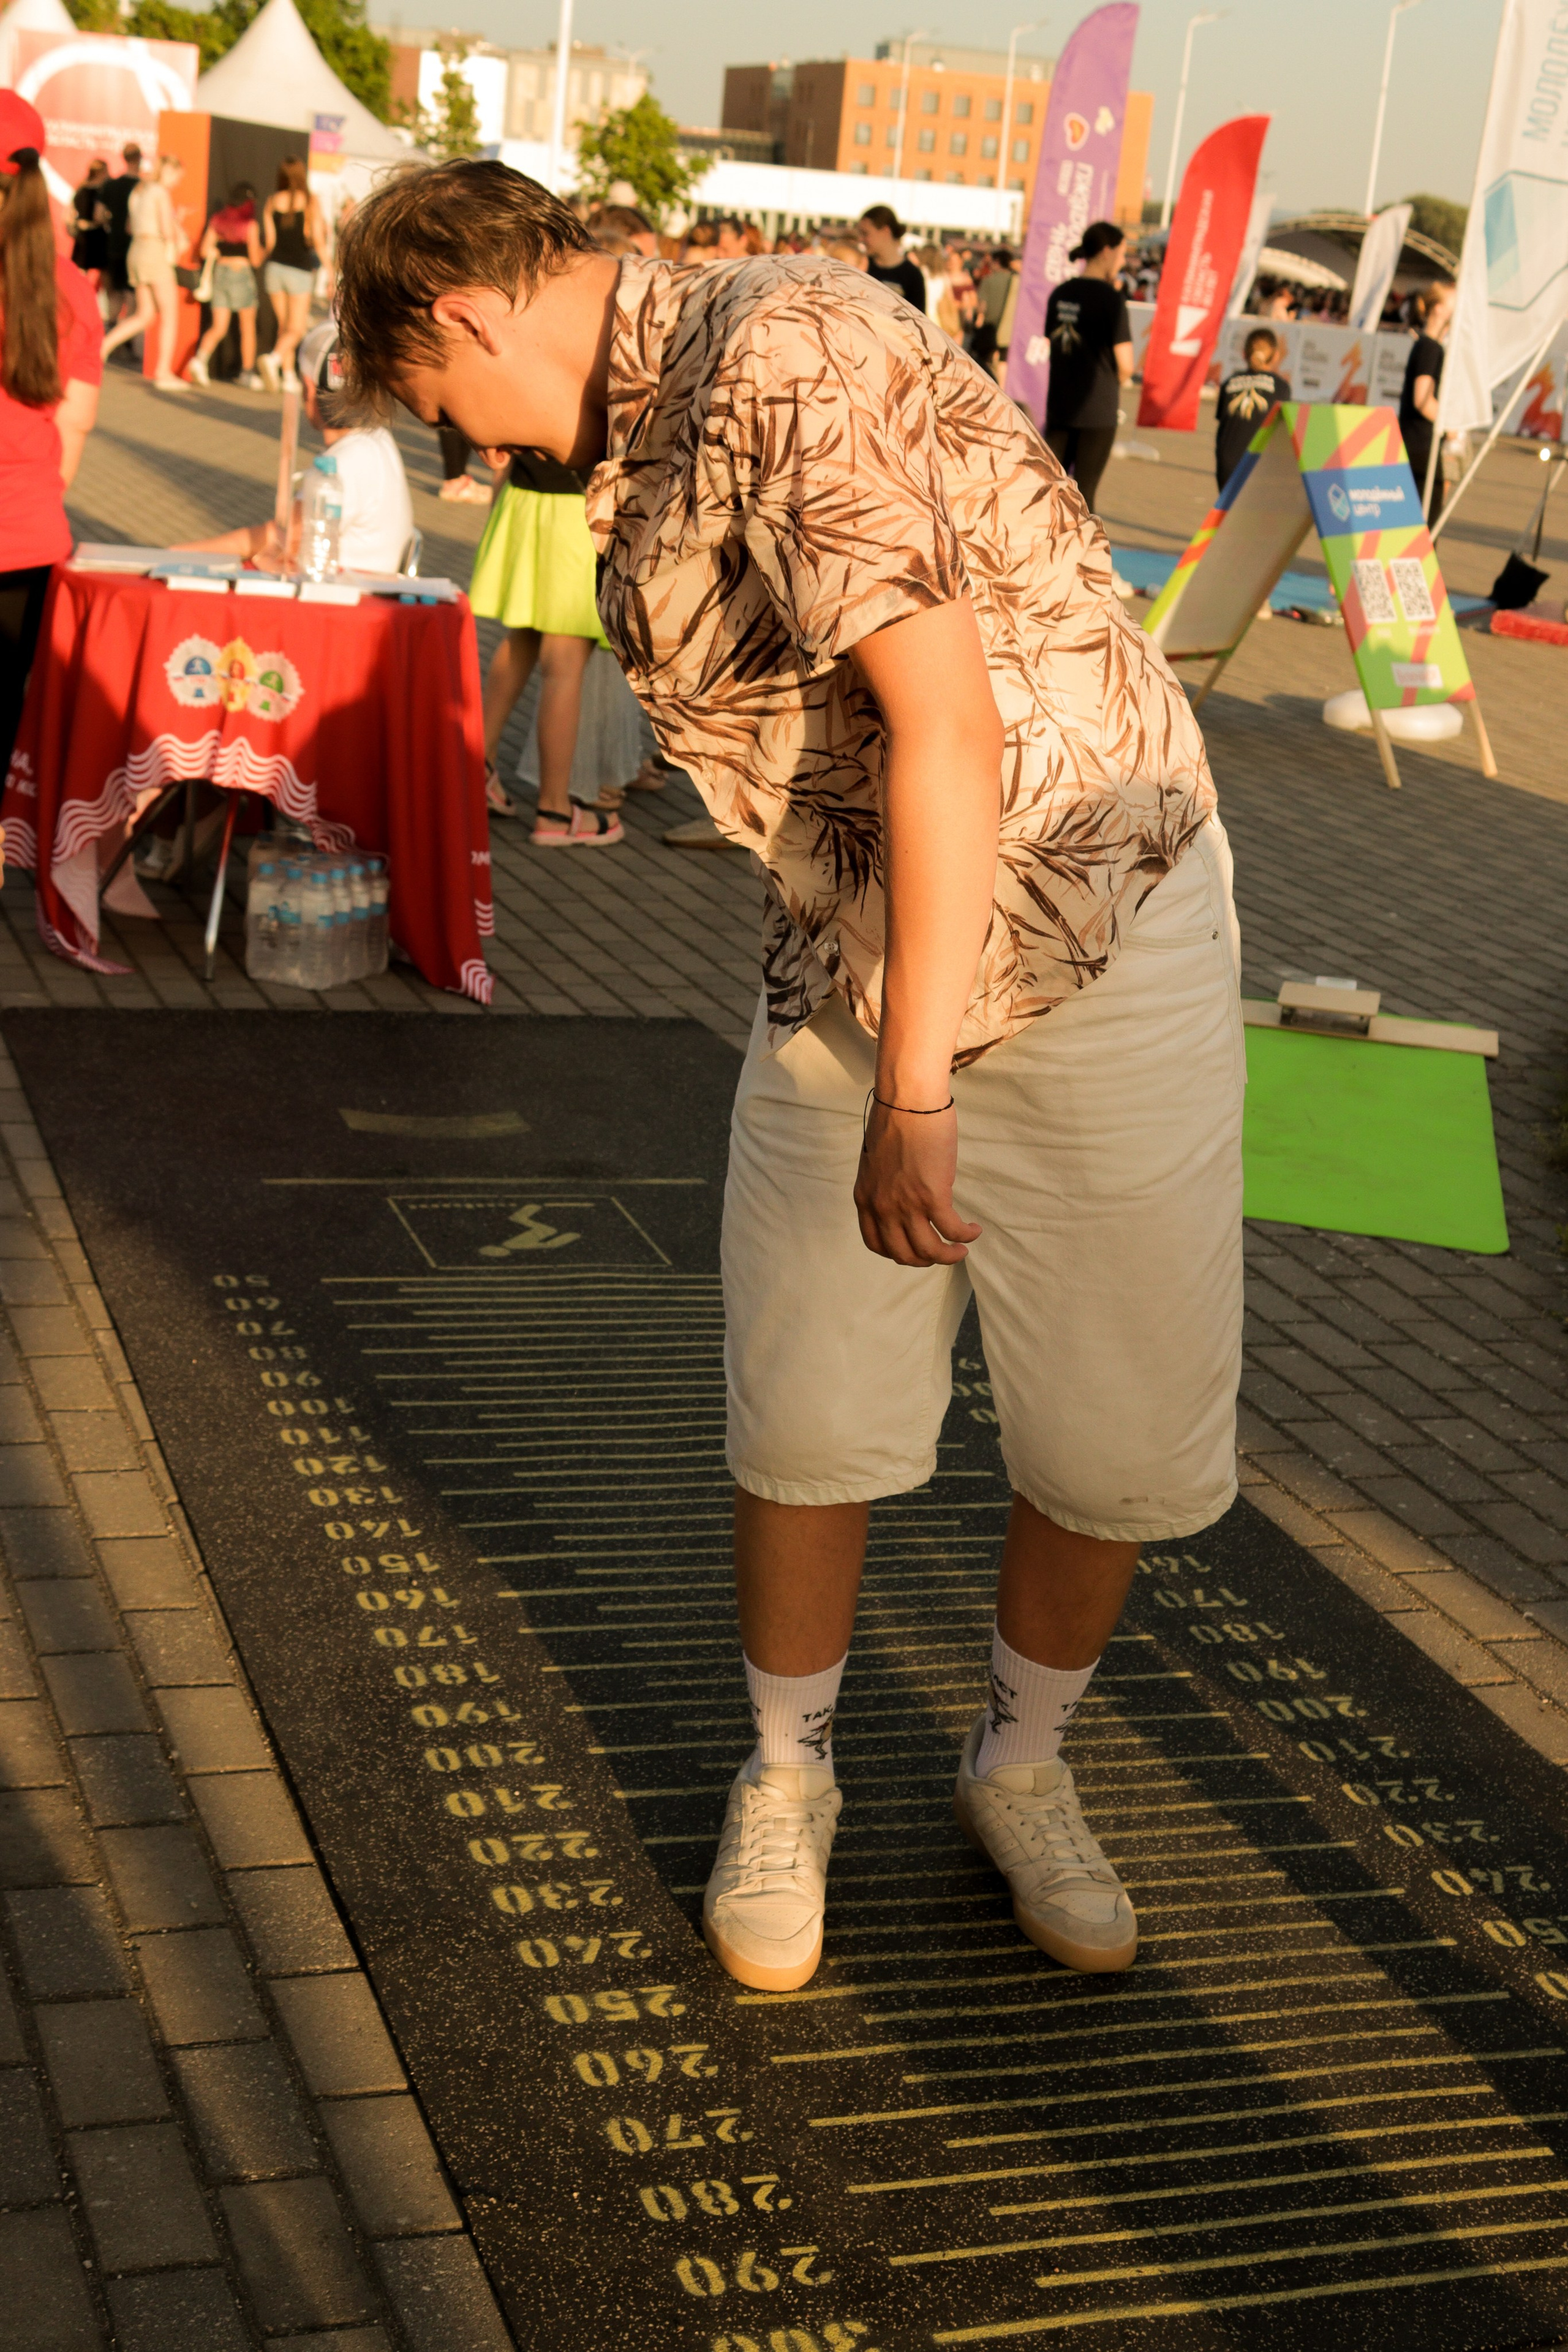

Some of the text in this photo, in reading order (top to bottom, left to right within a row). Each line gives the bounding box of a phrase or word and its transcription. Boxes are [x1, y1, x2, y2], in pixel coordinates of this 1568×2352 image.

[213, 1275, 270, 1287] 50
[225, 1297, 281, 1311] 60
[237, 1321, 296, 1336] 70
[249, 1346, 306, 1361] 80
[260, 1371, 322, 1387] 90
[267, 1398, 355, 1416] 100
[280, 1426, 371, 1445] 110
[293, 1455, 386, 1476] 120
[308, 1486, 403, 1507] 130
[324, 1518, 422, 1539] 140
[341, 1552, 440, 1575] 150
[356, 1588, 461, 1611] 160
[1153, 1588, 1248, 1608] 170
[374, 1626, 478, 1647] 170
[1189, 1621, 1286, 1644] 180
[394, 1662, 500, 1687] 180
[1226, 1658, 1327, 1682] 190
[411, 1701, 521, 1728] 190
[1256, 1697, 1368, 1722] 200
[424, 1742, 545, 1771] 200
[1298, 1737, 1410, 1762] 210
[446, 1784, 571, 1817] 210
[1341, 1778, 1455, 1806] 220
[1384, 1820, 1499, 1847] 230
[468, 1831, 598, 1865] 220
[1431, 1866, 1550, 1896] 240
[492, 1880, 623, 1913] 230
[1482, 1915, 1568, 1947] 50
[518, 1931, 652, 1968] 240
[546, 1985, 686, 2024] 250
[573, 2044, 718, 2086] 260
[607, 2108, 754, 2154] 270
[639, 2174, 792, 2222] 280
[676, 2245, 832, 2296] 290
